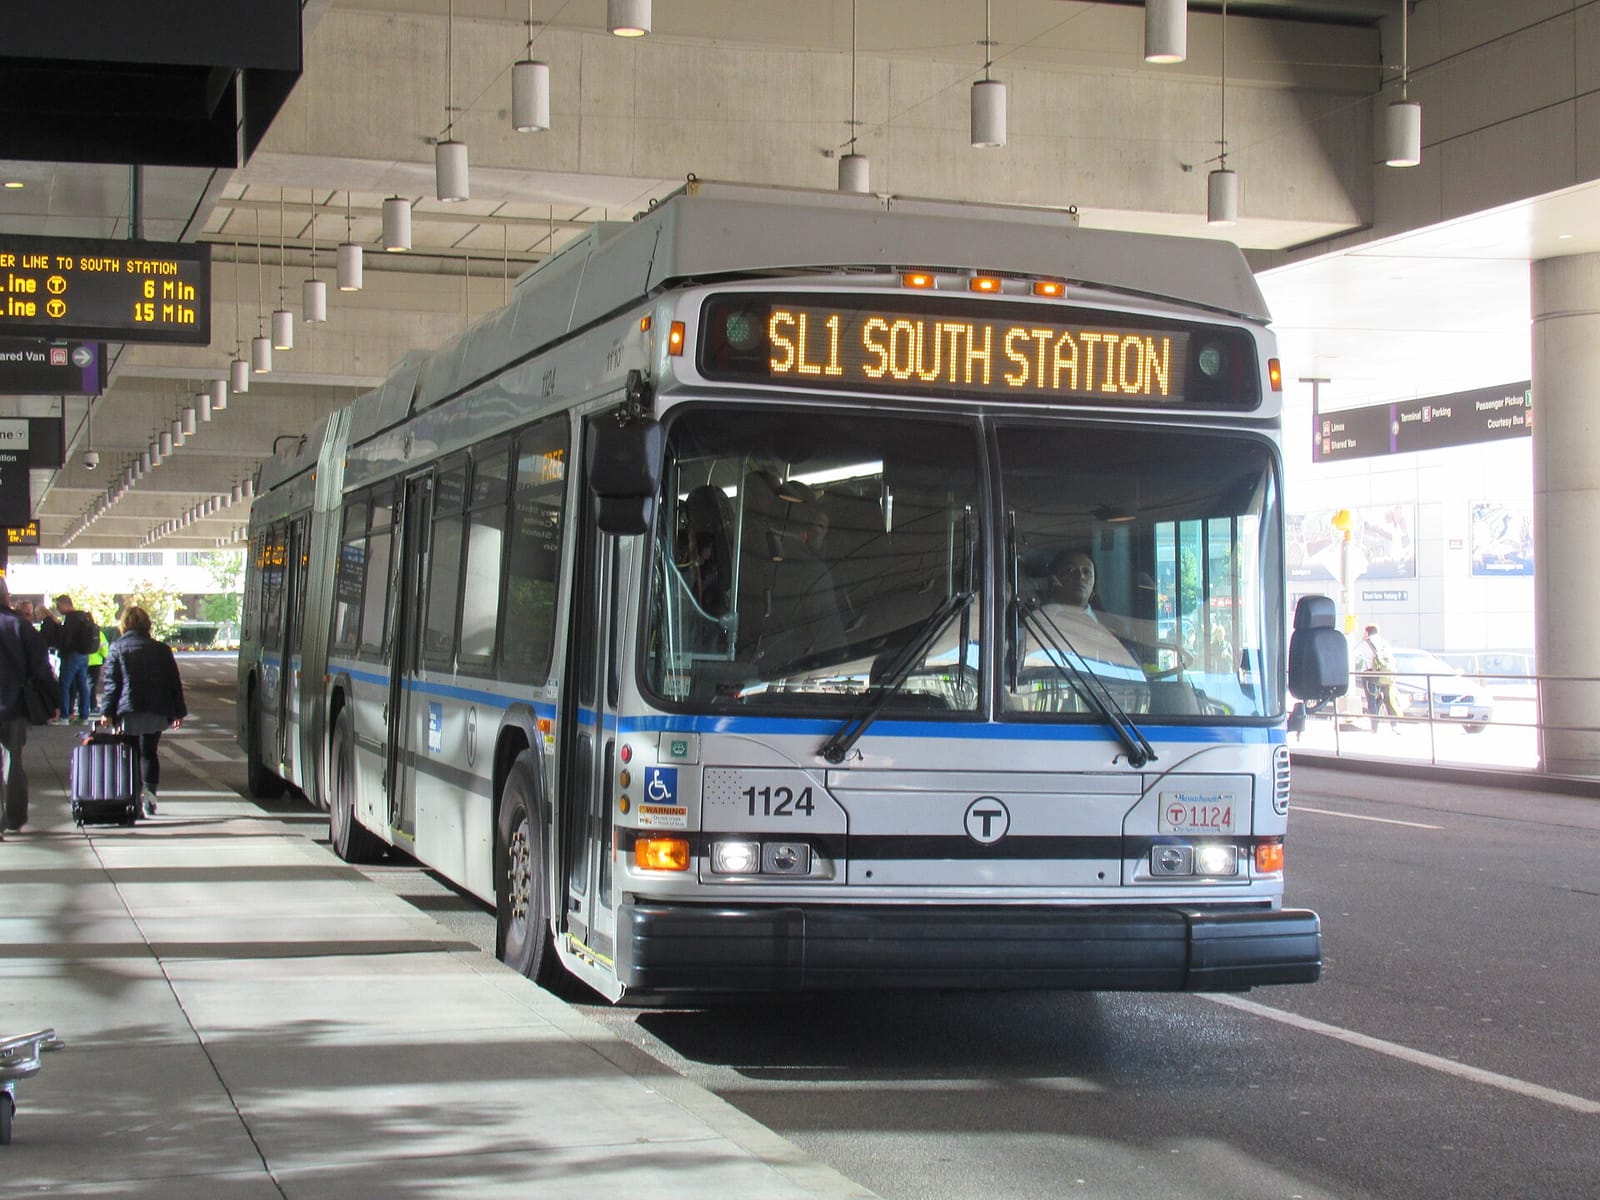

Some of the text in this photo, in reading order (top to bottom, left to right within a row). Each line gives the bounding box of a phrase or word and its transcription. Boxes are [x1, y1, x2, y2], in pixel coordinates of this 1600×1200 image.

[22, 255, 49, 269] LINE
[56, 256, 73, 270] TO
[80, 258, 120, 273] SOUTH
[126, 260, 178, 275] STATION
[0, 273, 36, 293] ine
[144, 280, 155, 299] 6
[163, 280, 195, 301] Min
[0, 297, 36, 317] ine
[134, 303, 155, 322] 15
[163, 304, 195, 324] Min
[0, 352, 46, 361] ared Van
[768, 311, 1171, 396] SL1 SOUTH STATION
[1475, 395, 1524, 411] Passenger Pickup
[1401, 411, 1422, 422] Terminal
[1432, 407, 1452, 418] Parking
[1487, 415, 1524, 429] Courtesy Bus
[1331, 439, 1357, 450] Shared Van
[742, 786, 815, 816] 1124
[646, 806, 686, 815] WARNING
[1190, 805, 1231, 827] 1124
